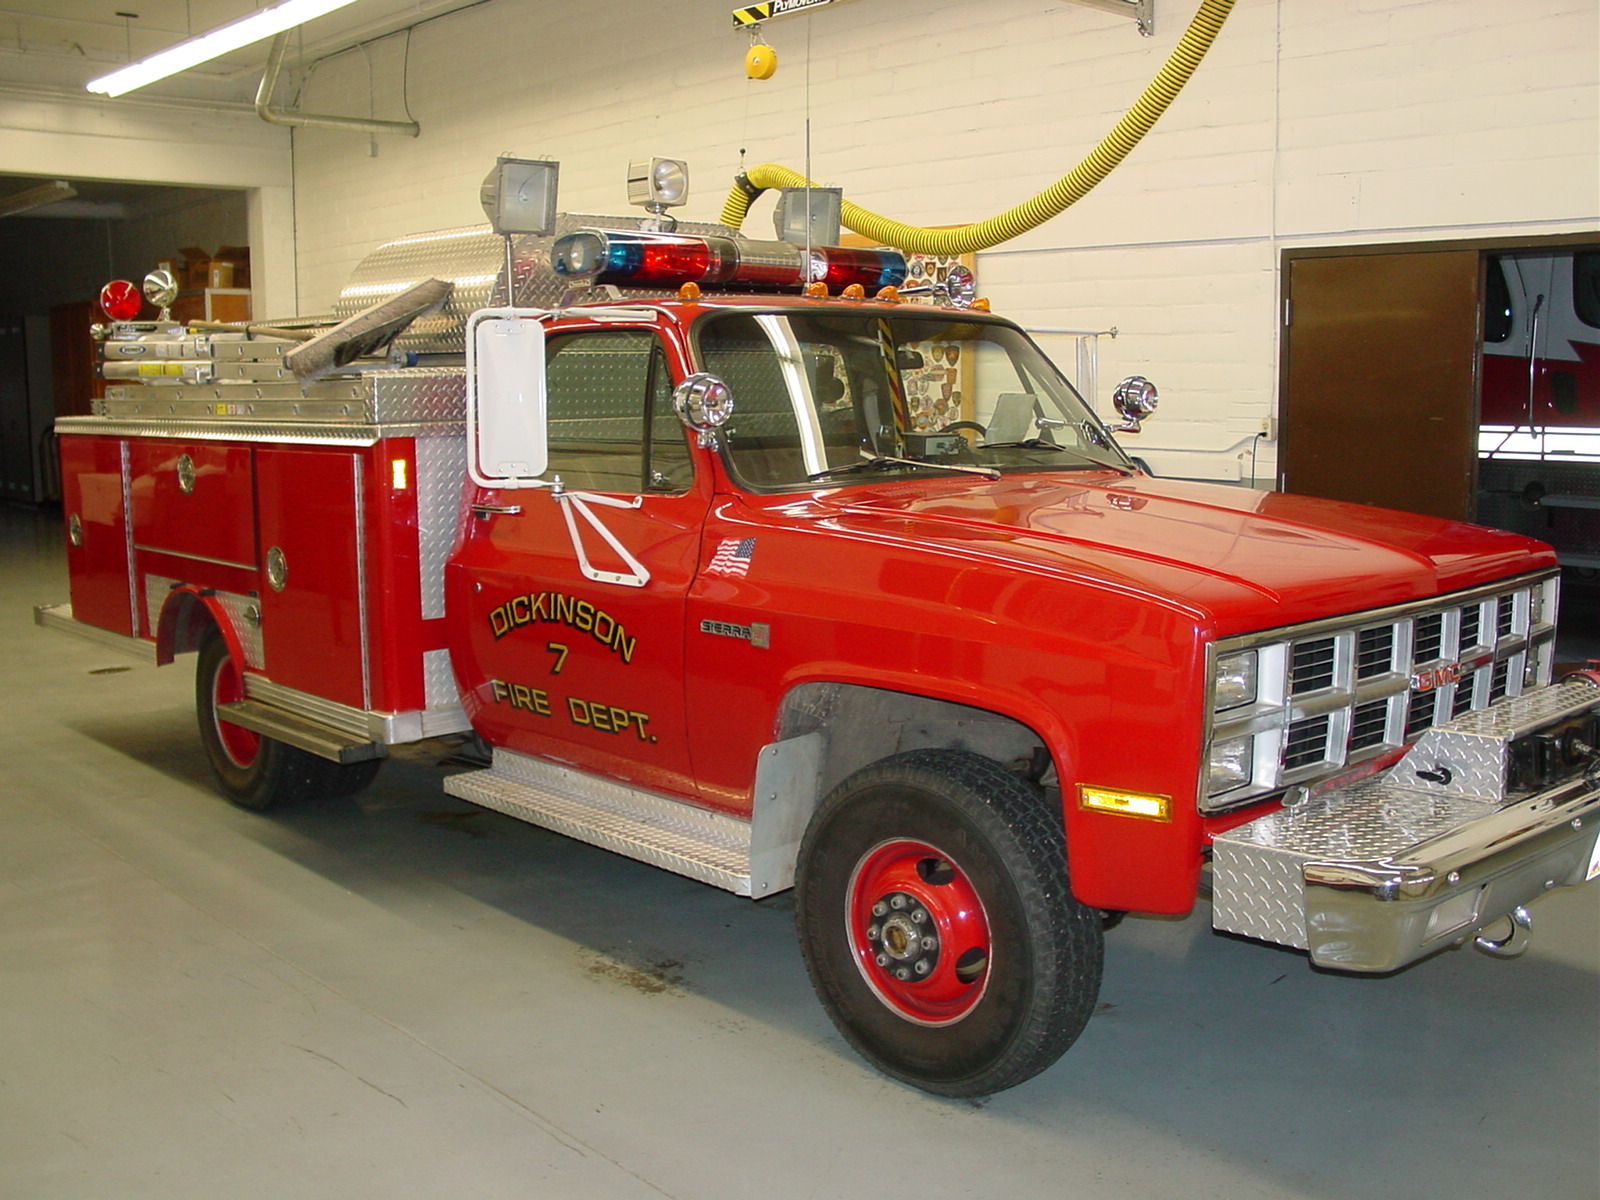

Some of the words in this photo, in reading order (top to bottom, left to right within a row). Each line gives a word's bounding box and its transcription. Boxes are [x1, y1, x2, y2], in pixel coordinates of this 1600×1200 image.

[489, 592, 636, 664] DICKINSON
[701, 620, 752, 640] SIERRA
[547, 643, 569, 674] 7
[1418, 664, 1461, 691] GMC
[491, 679, 552, 716] FIRE
[568, 697, 658, 743] DEPT.
